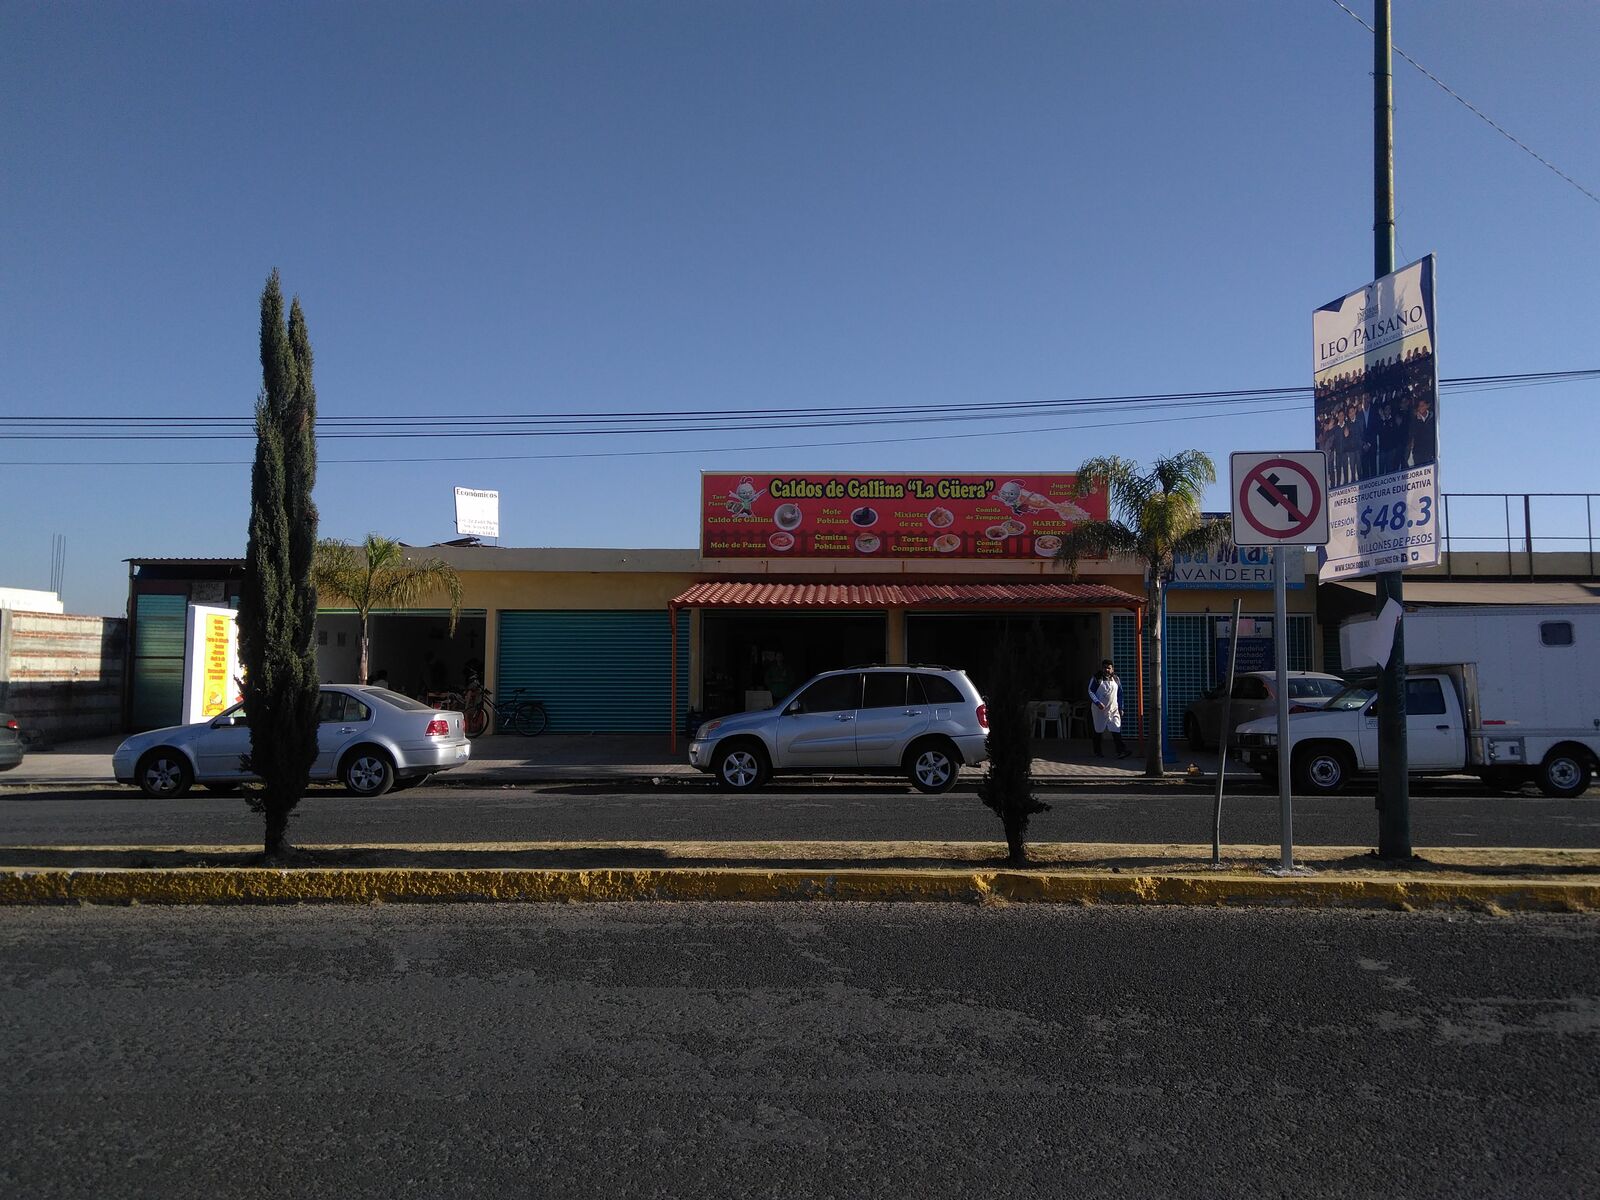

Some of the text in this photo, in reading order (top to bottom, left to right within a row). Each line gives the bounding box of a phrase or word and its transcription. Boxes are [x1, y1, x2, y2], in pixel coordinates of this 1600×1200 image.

[1321, 337, 1348, 361] LEO
[1353, 305, 1423, 347] PAISANO
[1401, 470, 1423, 480] MEJORA
[1424, 468, 1431, 476] EN
[456, 488, 498, 498] Económicos
[769, 479, 823, 499] Caldos
[825, 479, 844, 499] de
[847, 479, 904, 499] Gallina
[1334, 479, 1431, 507] INFRAESTRUCTURA EDUCATIVA
[1330, 496, 1432, 539] VERSIÓN $48.3
[1346, 529, 1356, 537] DE:
[1358, 533, 1432, 554] MILLONES DE PESOS
[1174, 568, 1288, 581] AVANDERI
